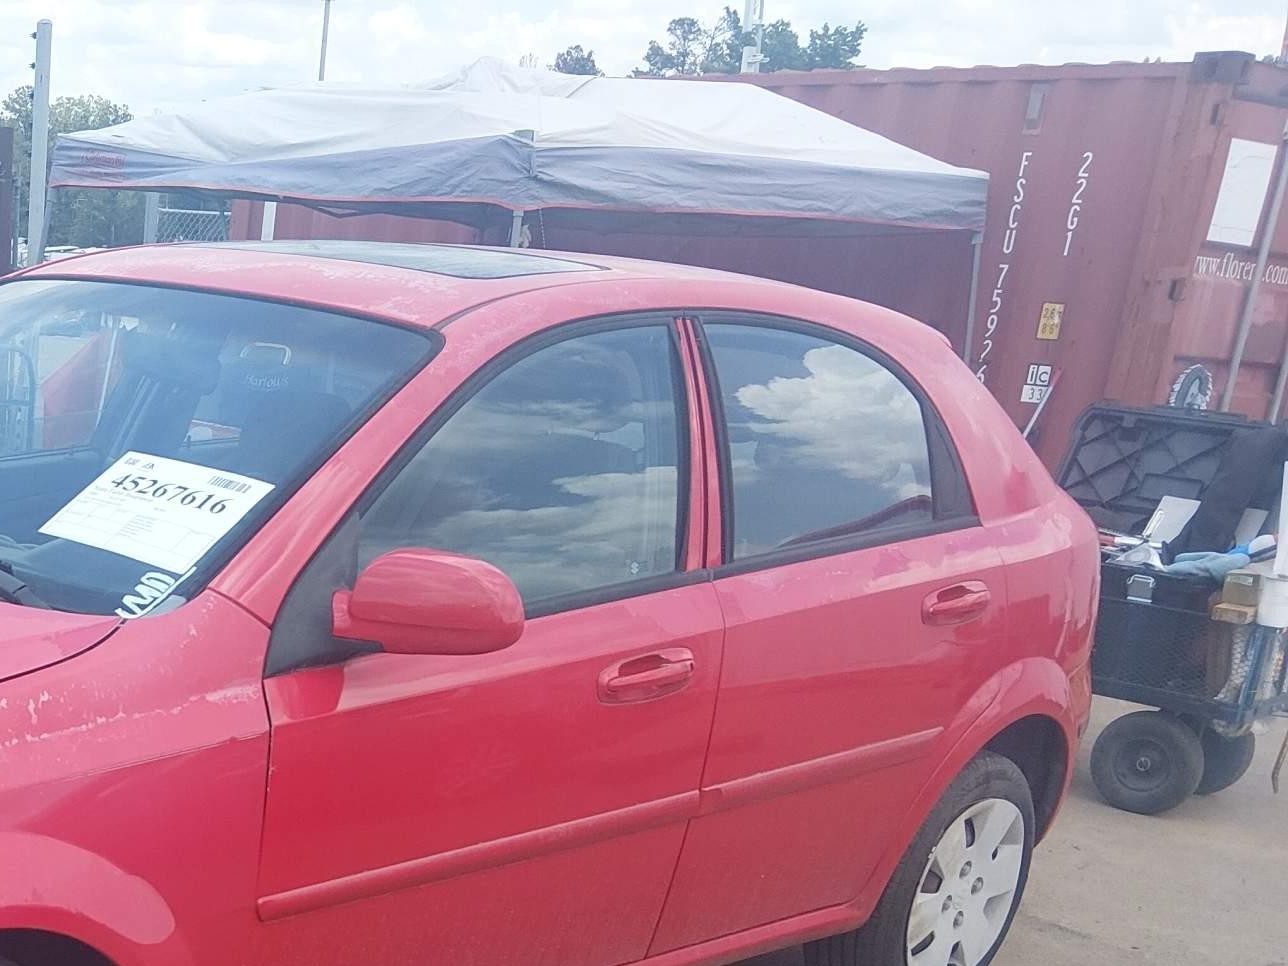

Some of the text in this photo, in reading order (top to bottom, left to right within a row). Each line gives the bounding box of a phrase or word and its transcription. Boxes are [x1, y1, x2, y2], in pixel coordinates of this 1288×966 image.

[1002, 151, 1033, 254] FSCU
[1063, 151, 1094, 256] 22G1
[111, 473, 234, 515] 45267616
